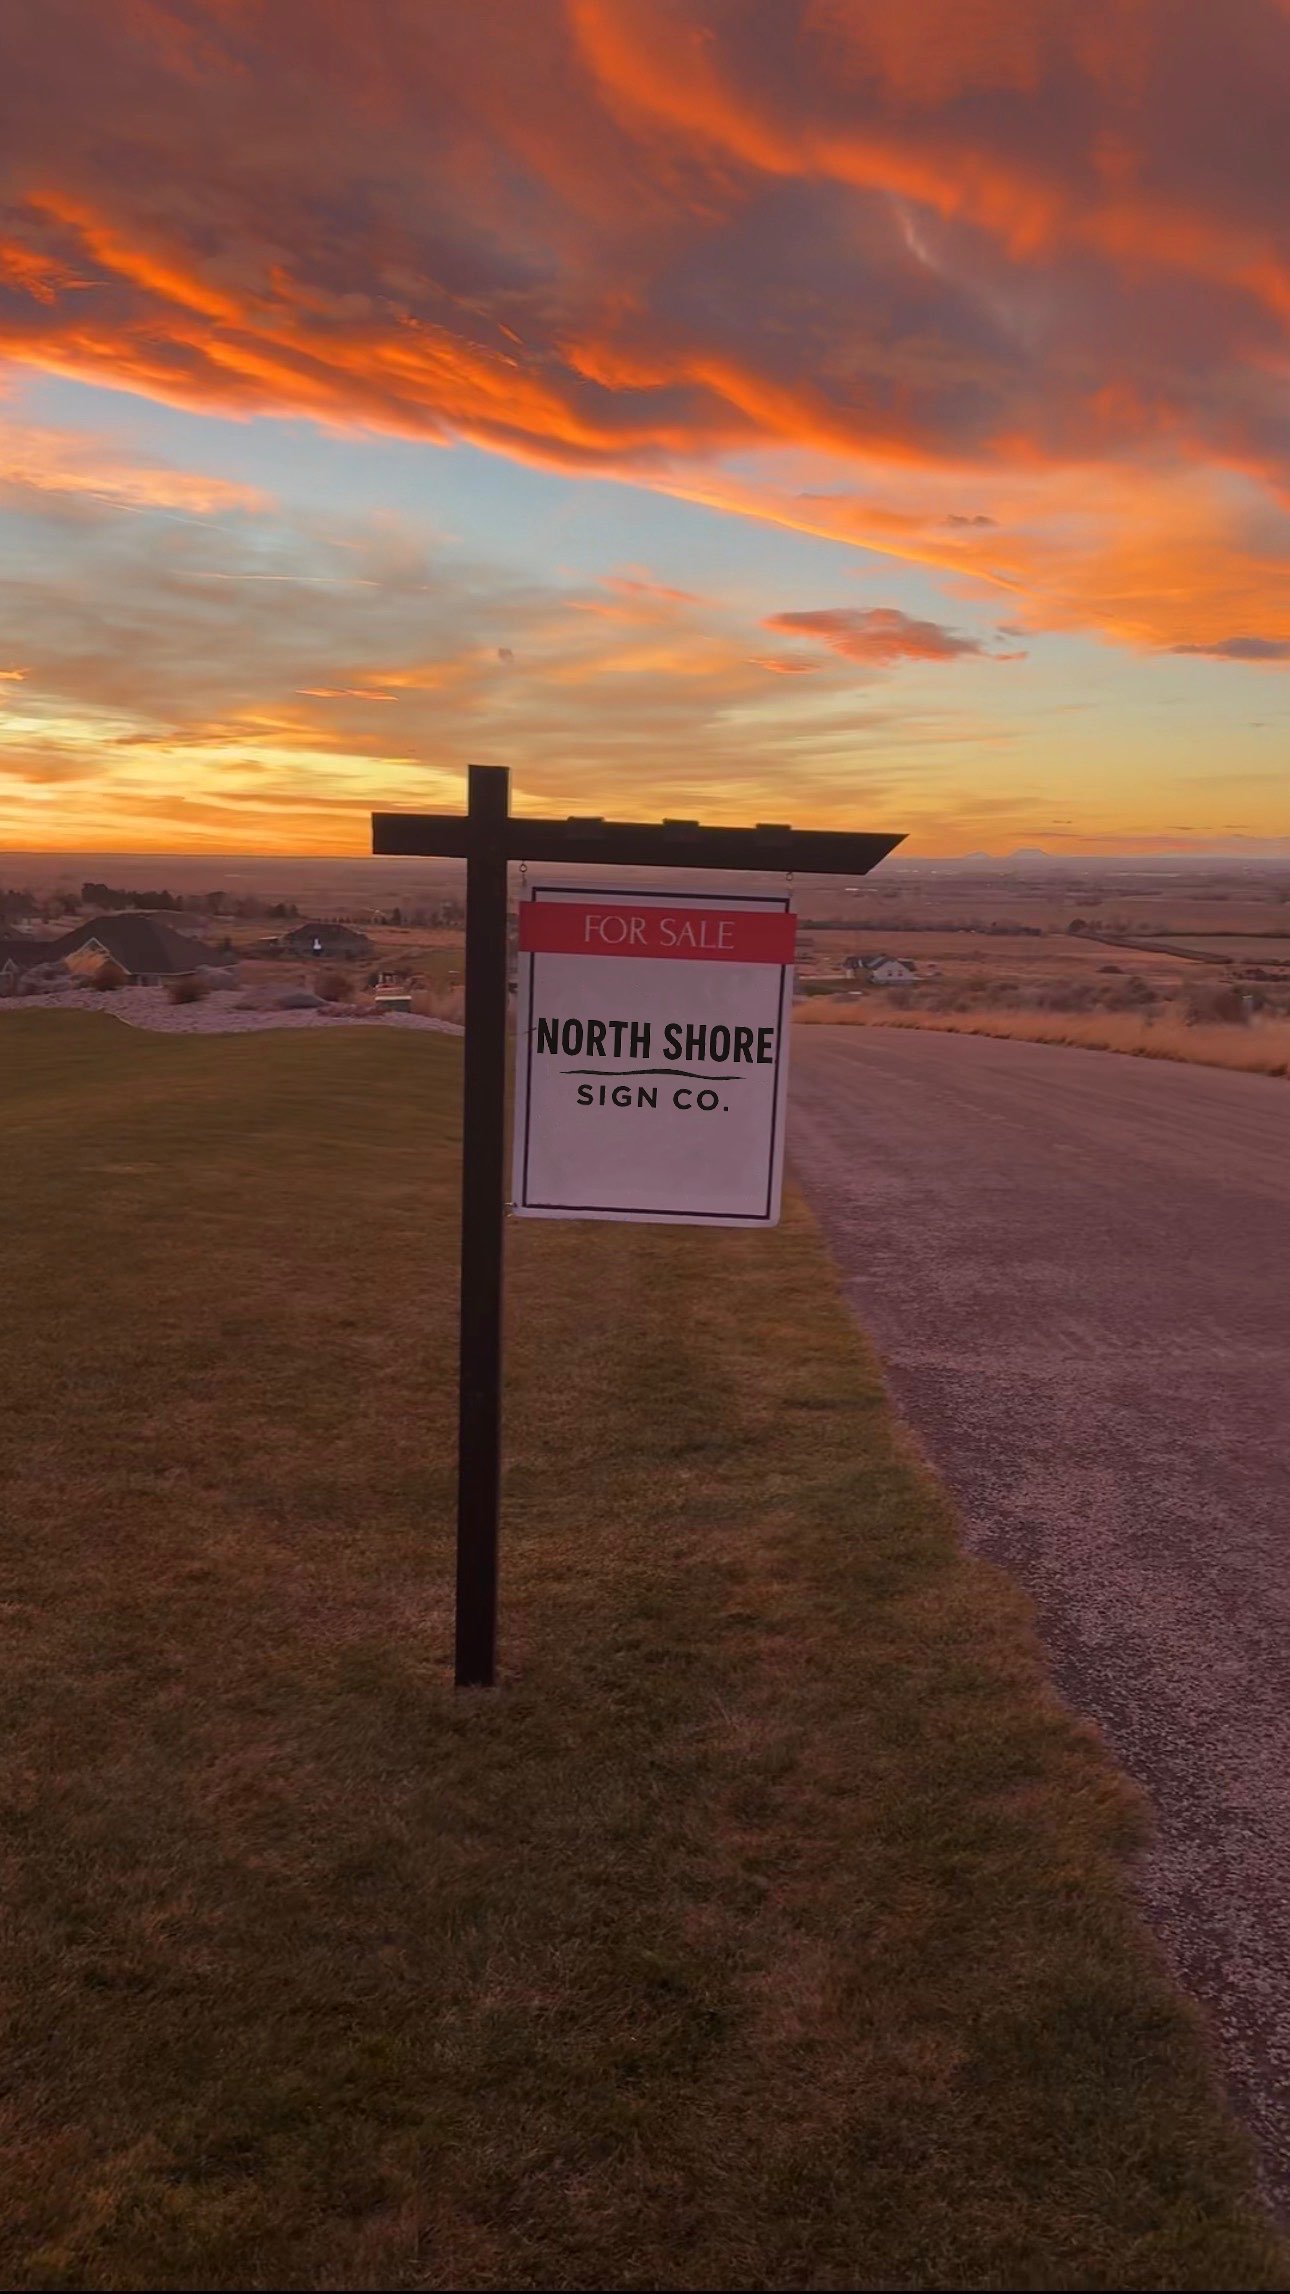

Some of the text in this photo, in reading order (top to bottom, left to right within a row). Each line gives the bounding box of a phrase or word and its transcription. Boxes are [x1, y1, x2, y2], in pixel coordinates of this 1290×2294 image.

[584, 915, 735, 949] FOR SALE
[537, 1017, 774, 1064] NORTH SHORE
[576, 1084, 729, 1112] SIGN CO.
